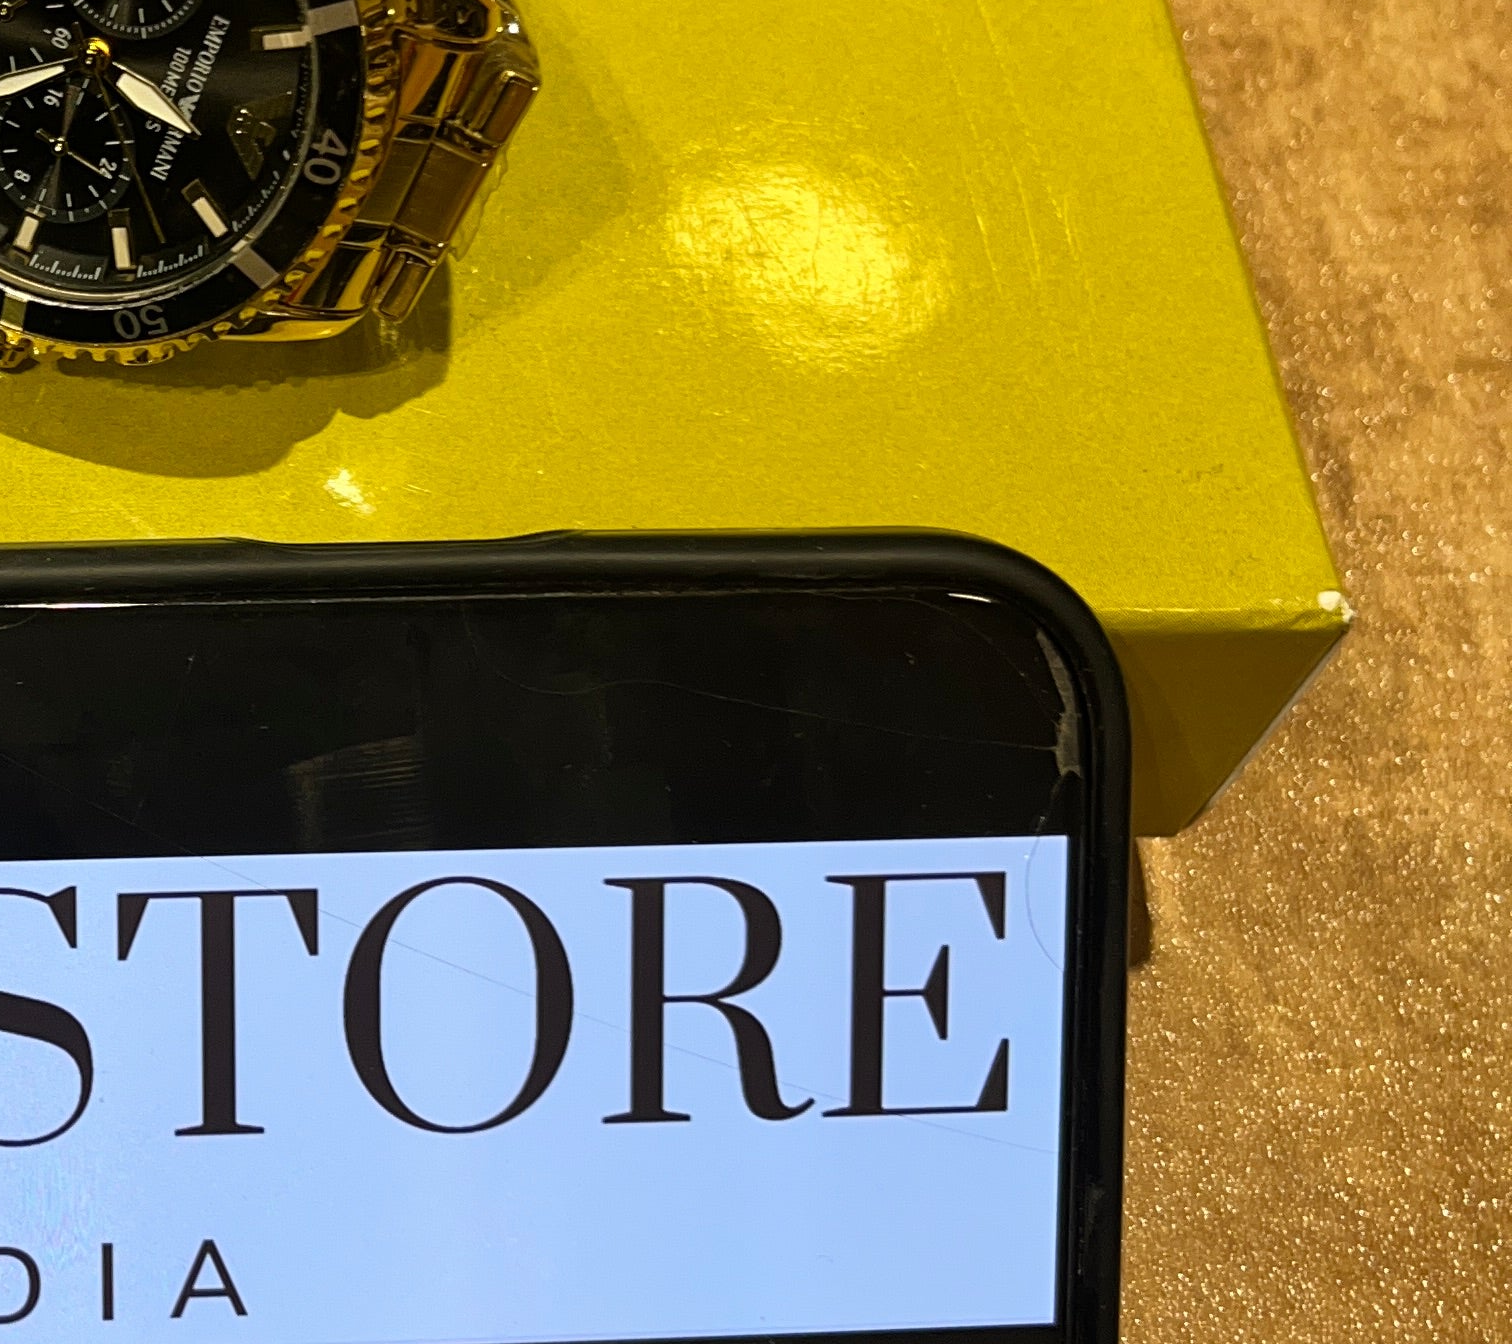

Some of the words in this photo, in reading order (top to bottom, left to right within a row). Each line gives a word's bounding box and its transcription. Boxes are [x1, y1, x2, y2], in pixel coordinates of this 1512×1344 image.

[50, 27, 72, 50] 60
[185, 14, 231, 93] EMPORIO
[43, 88, 64, 108] 16
[149, 125, 185, 182] RMANI
[303, 128, 348, 186] 40
[113, 305, 169, 340] 50
